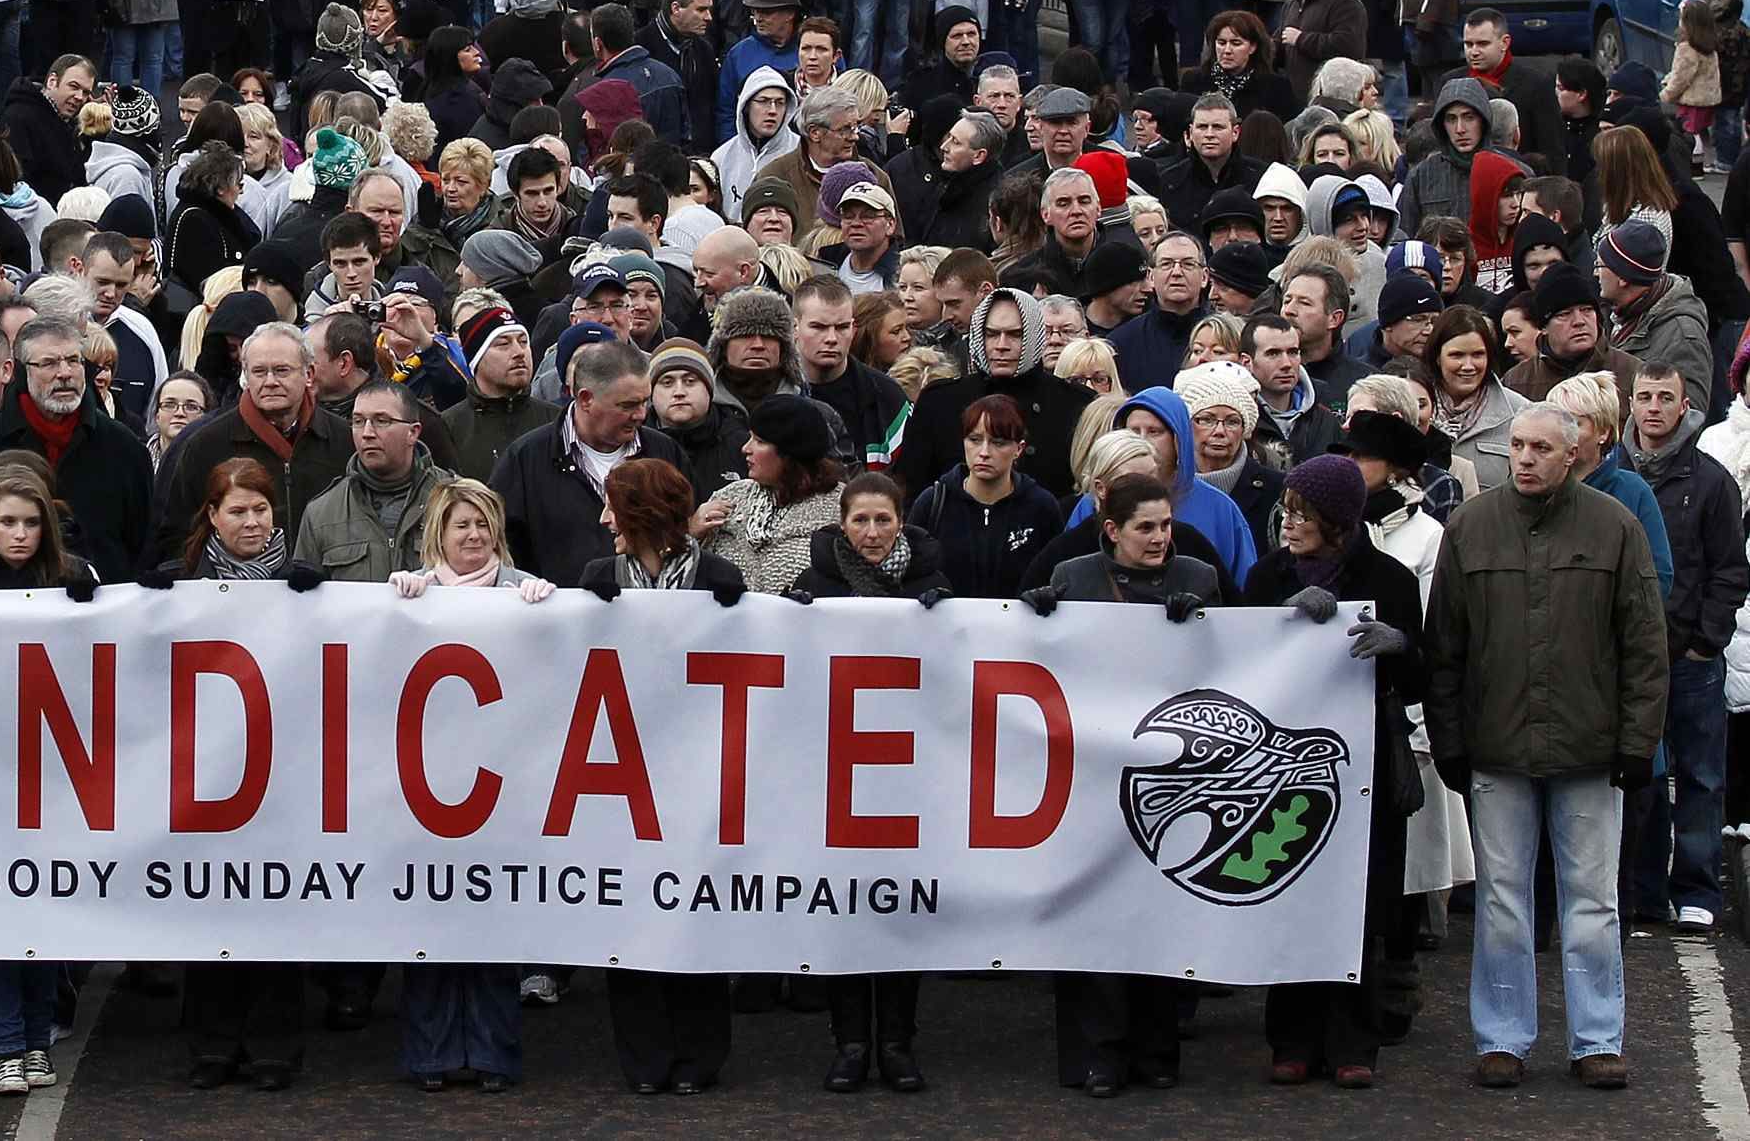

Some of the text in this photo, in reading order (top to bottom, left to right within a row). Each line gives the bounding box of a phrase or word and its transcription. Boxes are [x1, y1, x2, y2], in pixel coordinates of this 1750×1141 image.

[144, 860, 367, 900] SUNDAY
[392, 862, 624, 907] JUSTICE
[652, 870, 940, 915] CAMPAIGN
